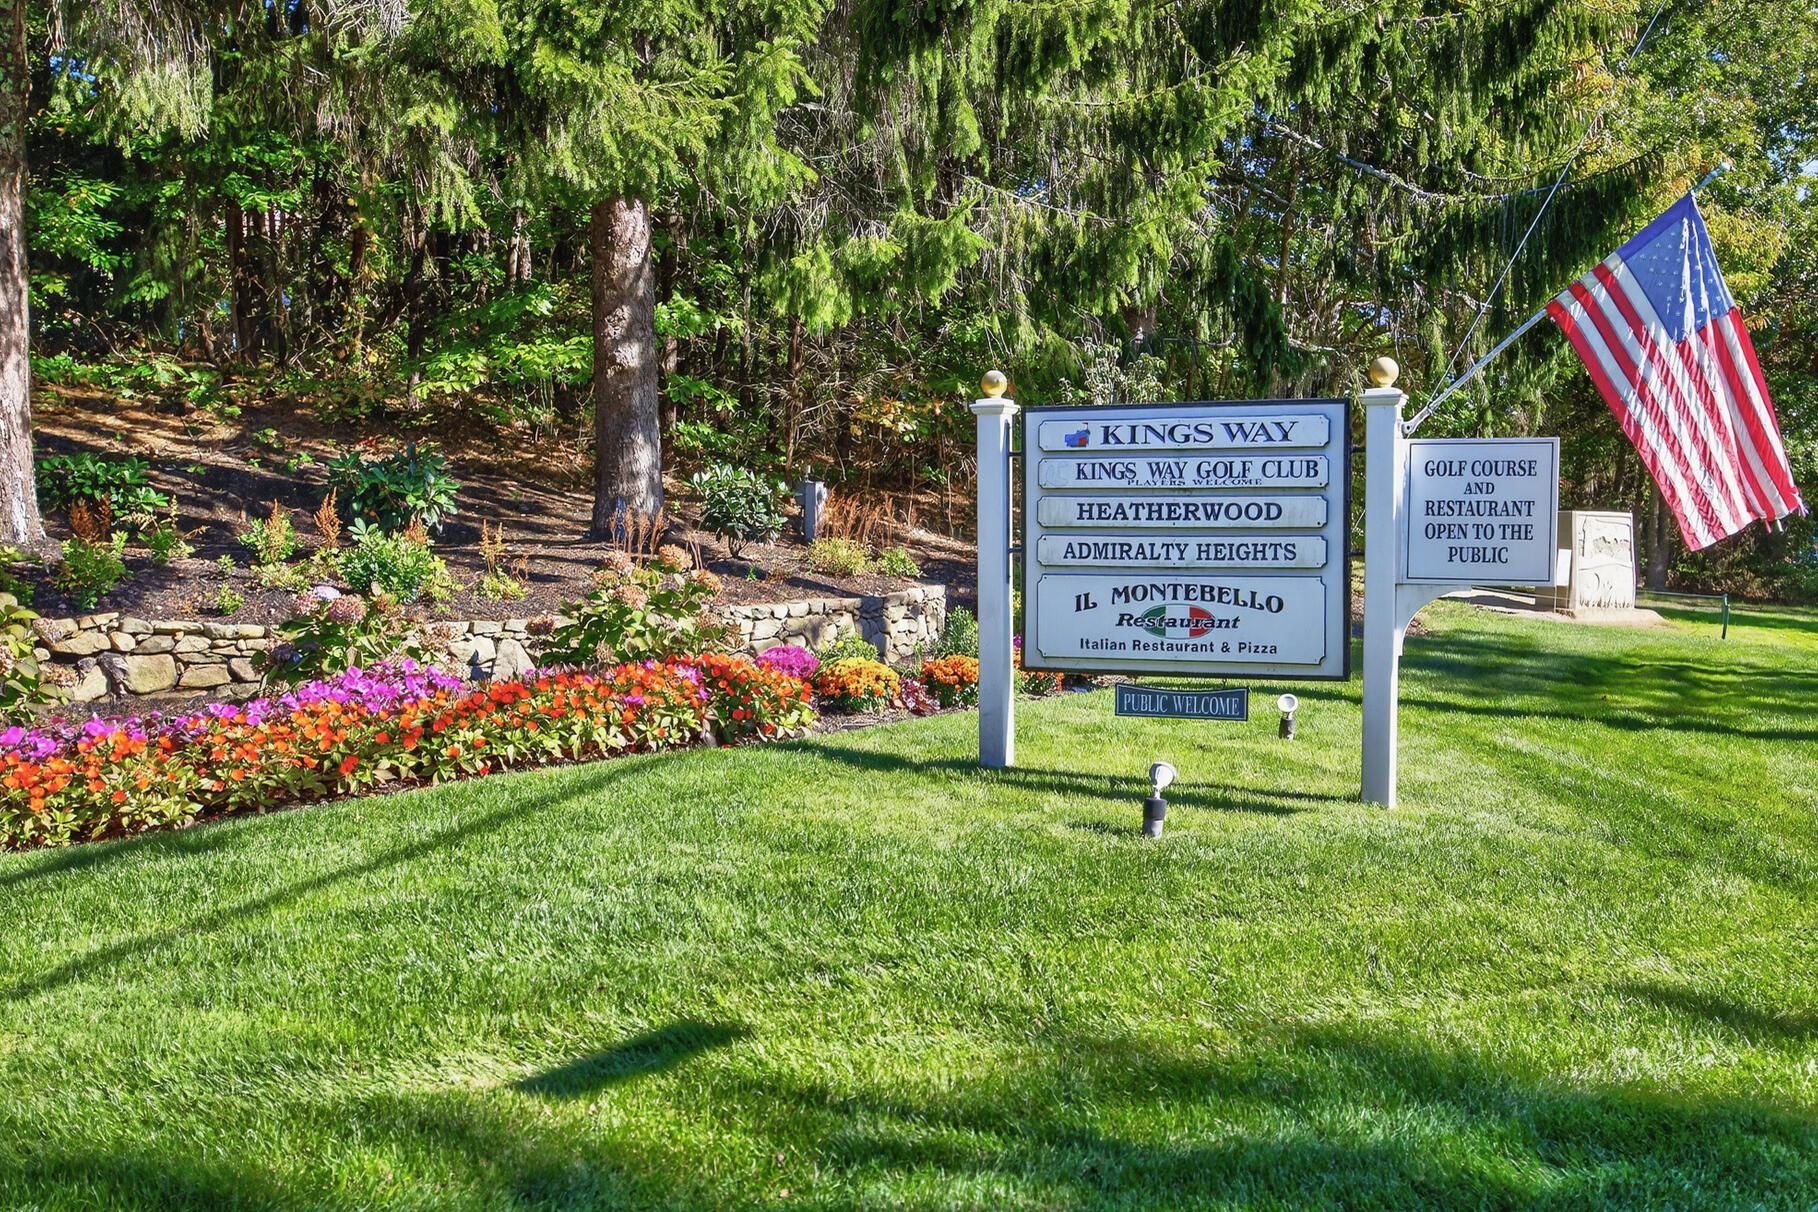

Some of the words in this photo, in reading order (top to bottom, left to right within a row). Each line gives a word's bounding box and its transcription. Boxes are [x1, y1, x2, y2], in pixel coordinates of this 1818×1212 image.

[1100, 423, 1213, 445] KINGS
[1221, 420, 1299, 442] WAY
[1075, 461, 1137, 481] KINGS
[1146, 461, 1189, 480] WAY
[1196, 460, 1253, 479] GOLF
[1261, 459, 1320, 479] CLUB
[1424, 460, 1468, 477] GOLF
[1471, 460, 1537, 477] COURSE
[1464, 482, 1495, 495] AND
[1076, 502, 1283, 521] HEATHERWOOD
[1424, 500, 1535, 517] RESTAURANT
[1424, 523, 1469, 540] OPEN
[1472, 523, 1495, 541] TO
[1499, 523, 1534, 541] THE
[1063, 542, 1190, 562] ADMIRALTY
[1196, 542, 1297, 562] HEIGHTS
[1447, 546, 1509, 564] PUBLIC
[1074, 592, 1098, 612] IL
[1111, 583, 1285, 614] MONTEBELLO
[1115, 613, 1241, 629] Restaurant
[1080, 638, 1127, 651] Italian
[1132, 639, 1215, 653] Restaurant
[1221, 642, 1230, 654] &
[1238, 642, 1278, 655] Pizza
[1123, 693, 1169, 713] PUBLIC
[1172, 695, 1240, 716] WELCOME
